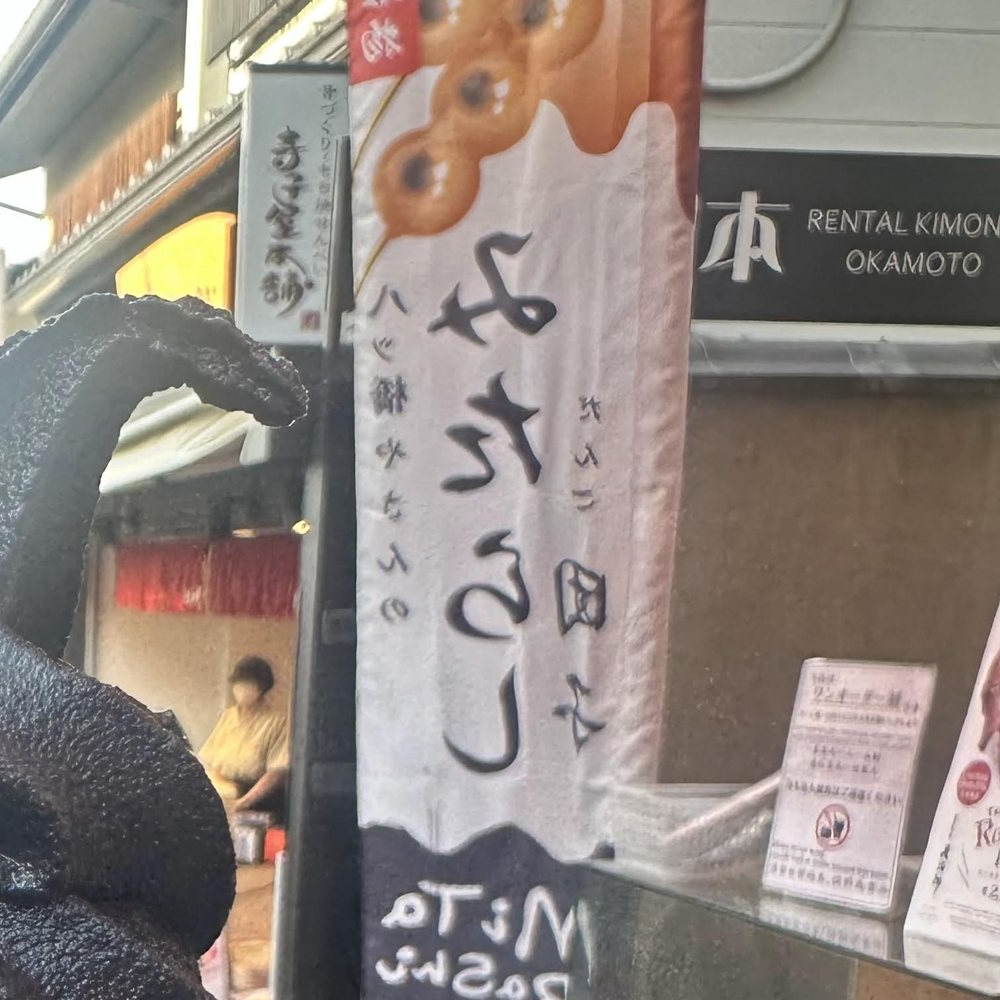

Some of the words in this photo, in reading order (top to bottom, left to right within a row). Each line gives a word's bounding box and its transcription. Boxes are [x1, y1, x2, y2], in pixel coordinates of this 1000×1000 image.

[808, 208, 908, 235] RENTAL
[915, 211, 1000, 237] KIMON
[846, 248, 982, 277] OKAMOTO
